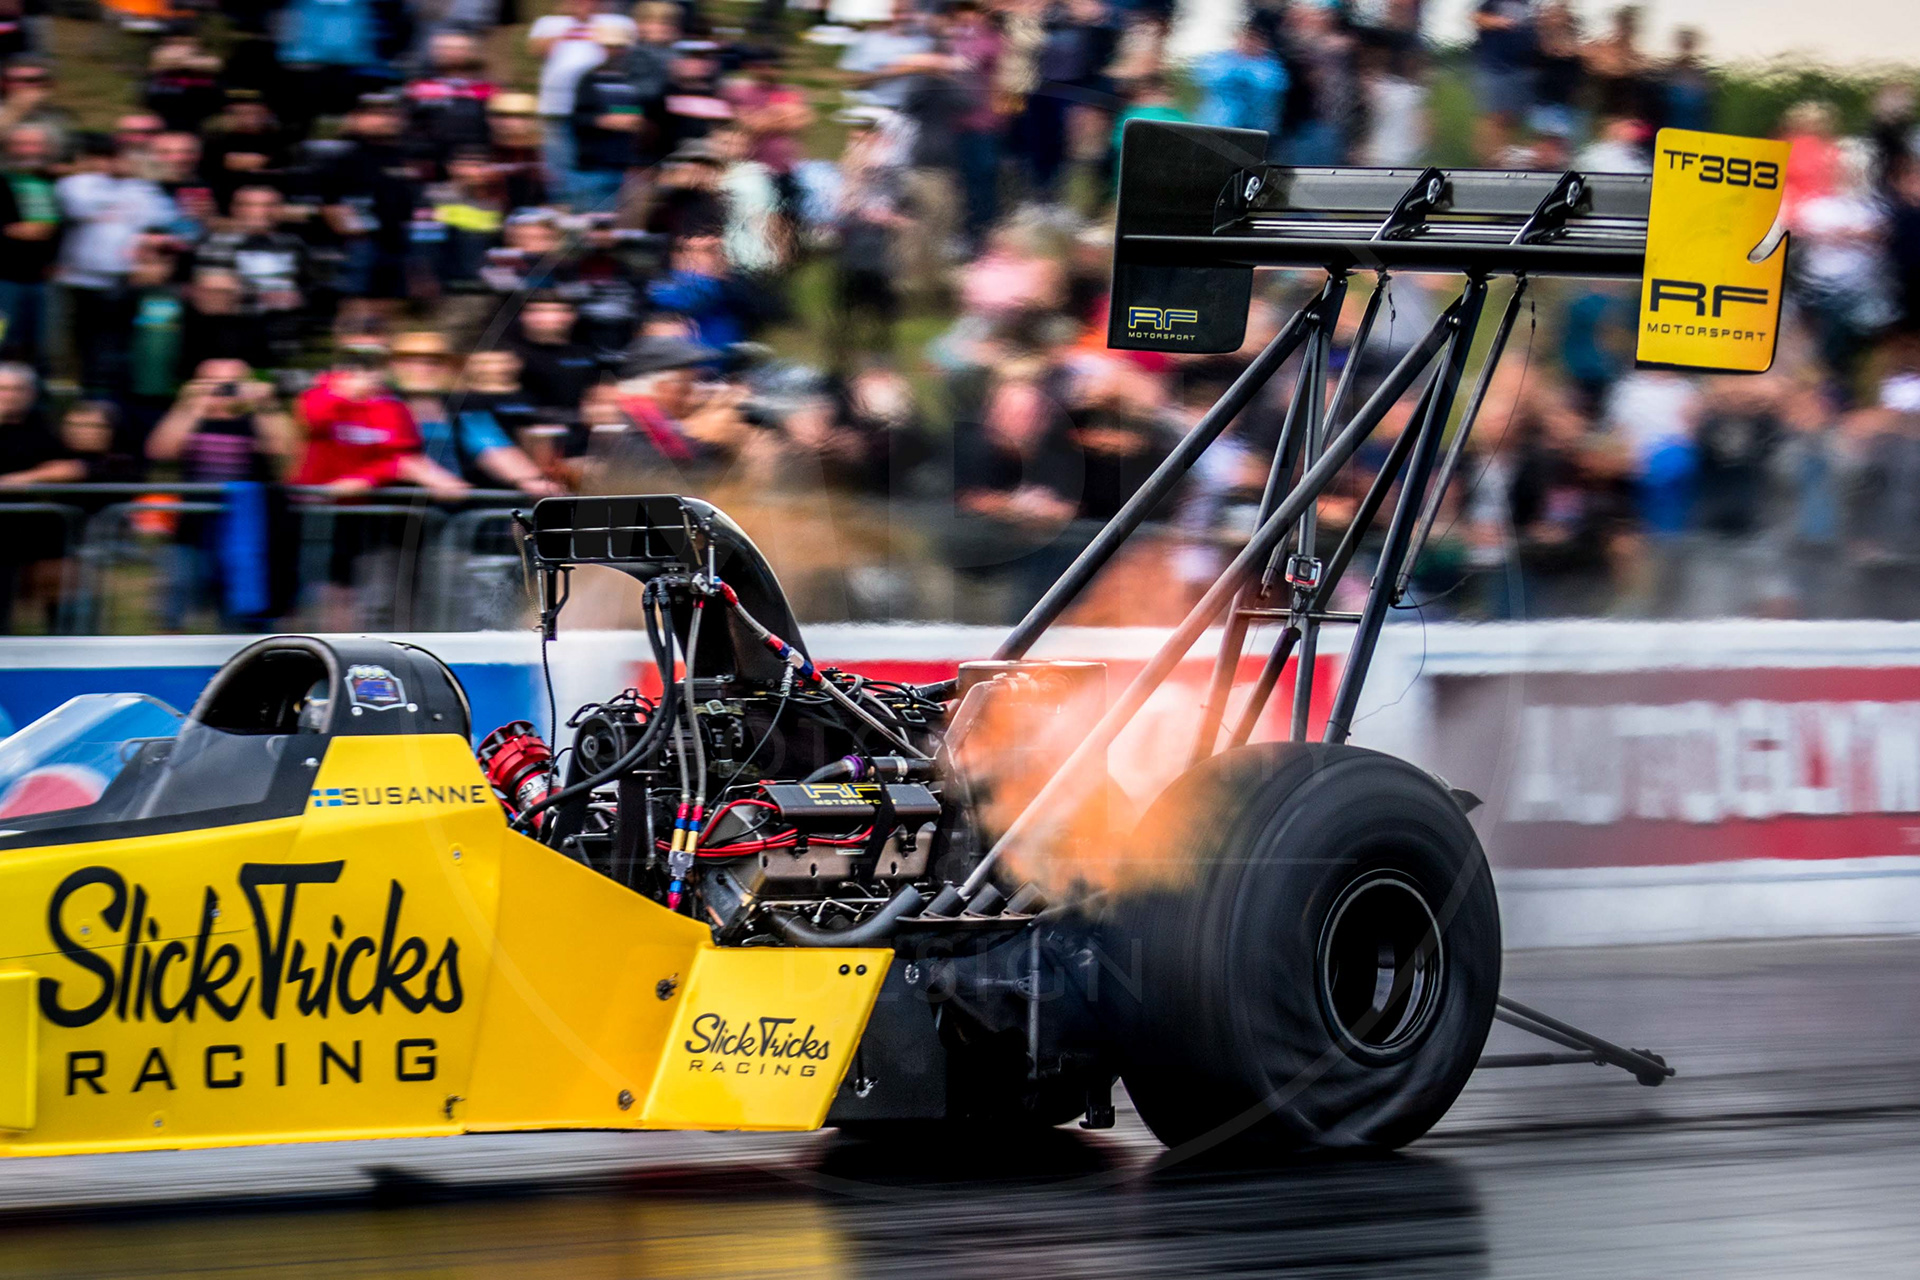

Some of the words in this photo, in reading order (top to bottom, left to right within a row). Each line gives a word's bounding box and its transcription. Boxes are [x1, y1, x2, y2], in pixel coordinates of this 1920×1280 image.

[1662, 149, 1780, 190] TF393
[1649, 278, 1769, 318] RF
[1127, 306, 1198, 331] RF
[1127, 331, 1197, 341] MOTORSPORT
[1646, 322, 1767, 342] MOTORSPORT
[342, 785, 486, 806] SUSANNE
[799, 783, 883, 799] RF
[813, 798, 898, 806] MOTORSPOT
[66, 1038, 438, 1096] RACING
[688, 1059, 817, 1077] RACING
